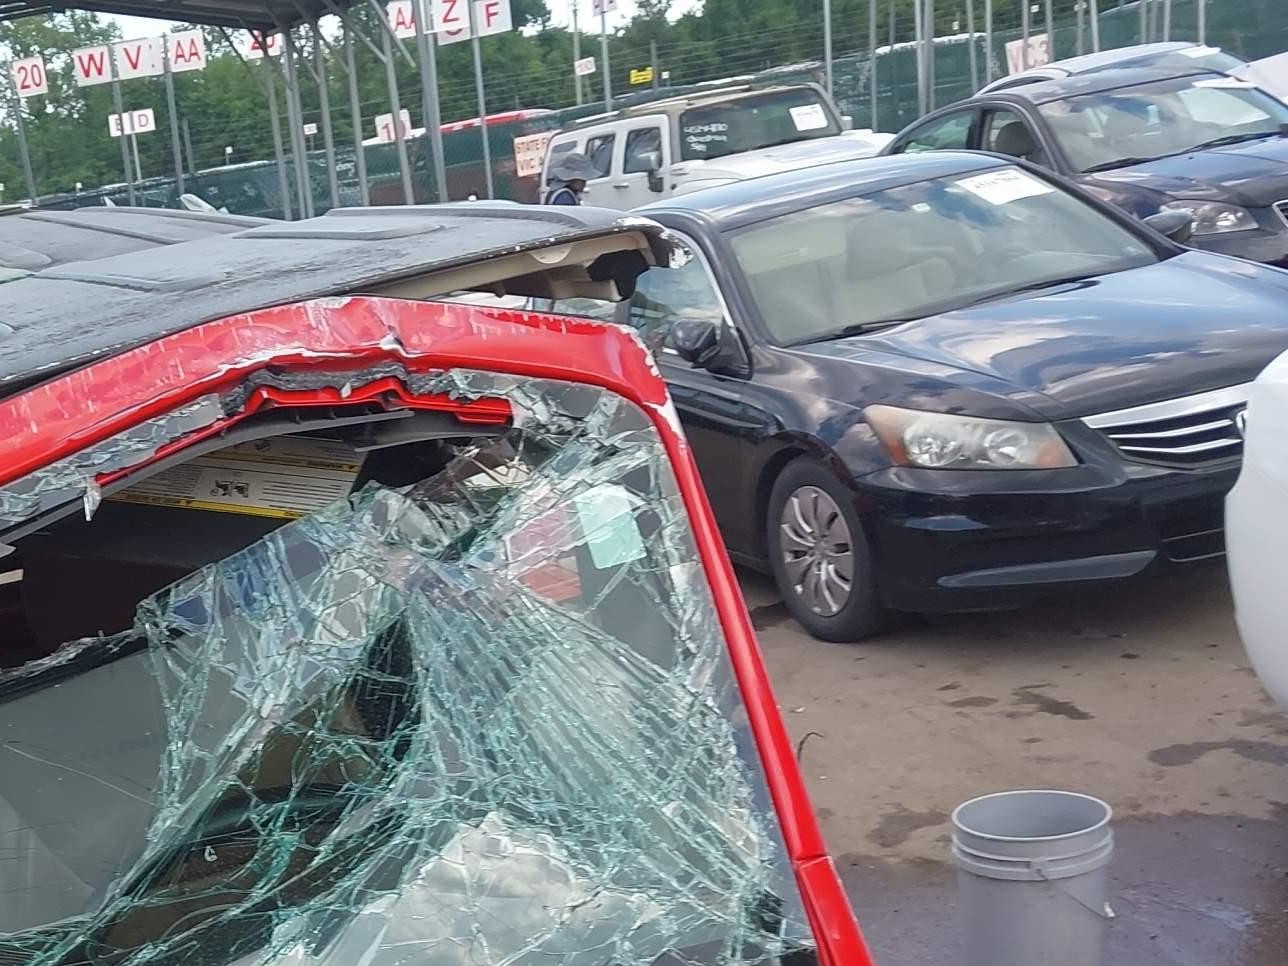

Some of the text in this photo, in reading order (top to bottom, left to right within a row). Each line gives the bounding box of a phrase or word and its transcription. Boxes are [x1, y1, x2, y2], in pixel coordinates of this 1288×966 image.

[485, 2, 499, 28] F
[123, 45, 142, 70] V
[173, 37, 201, 65] AA
[17, 63, 43, 90] 20
[77, 51, 105, 79] W
[138, 113, 149, 128] D
